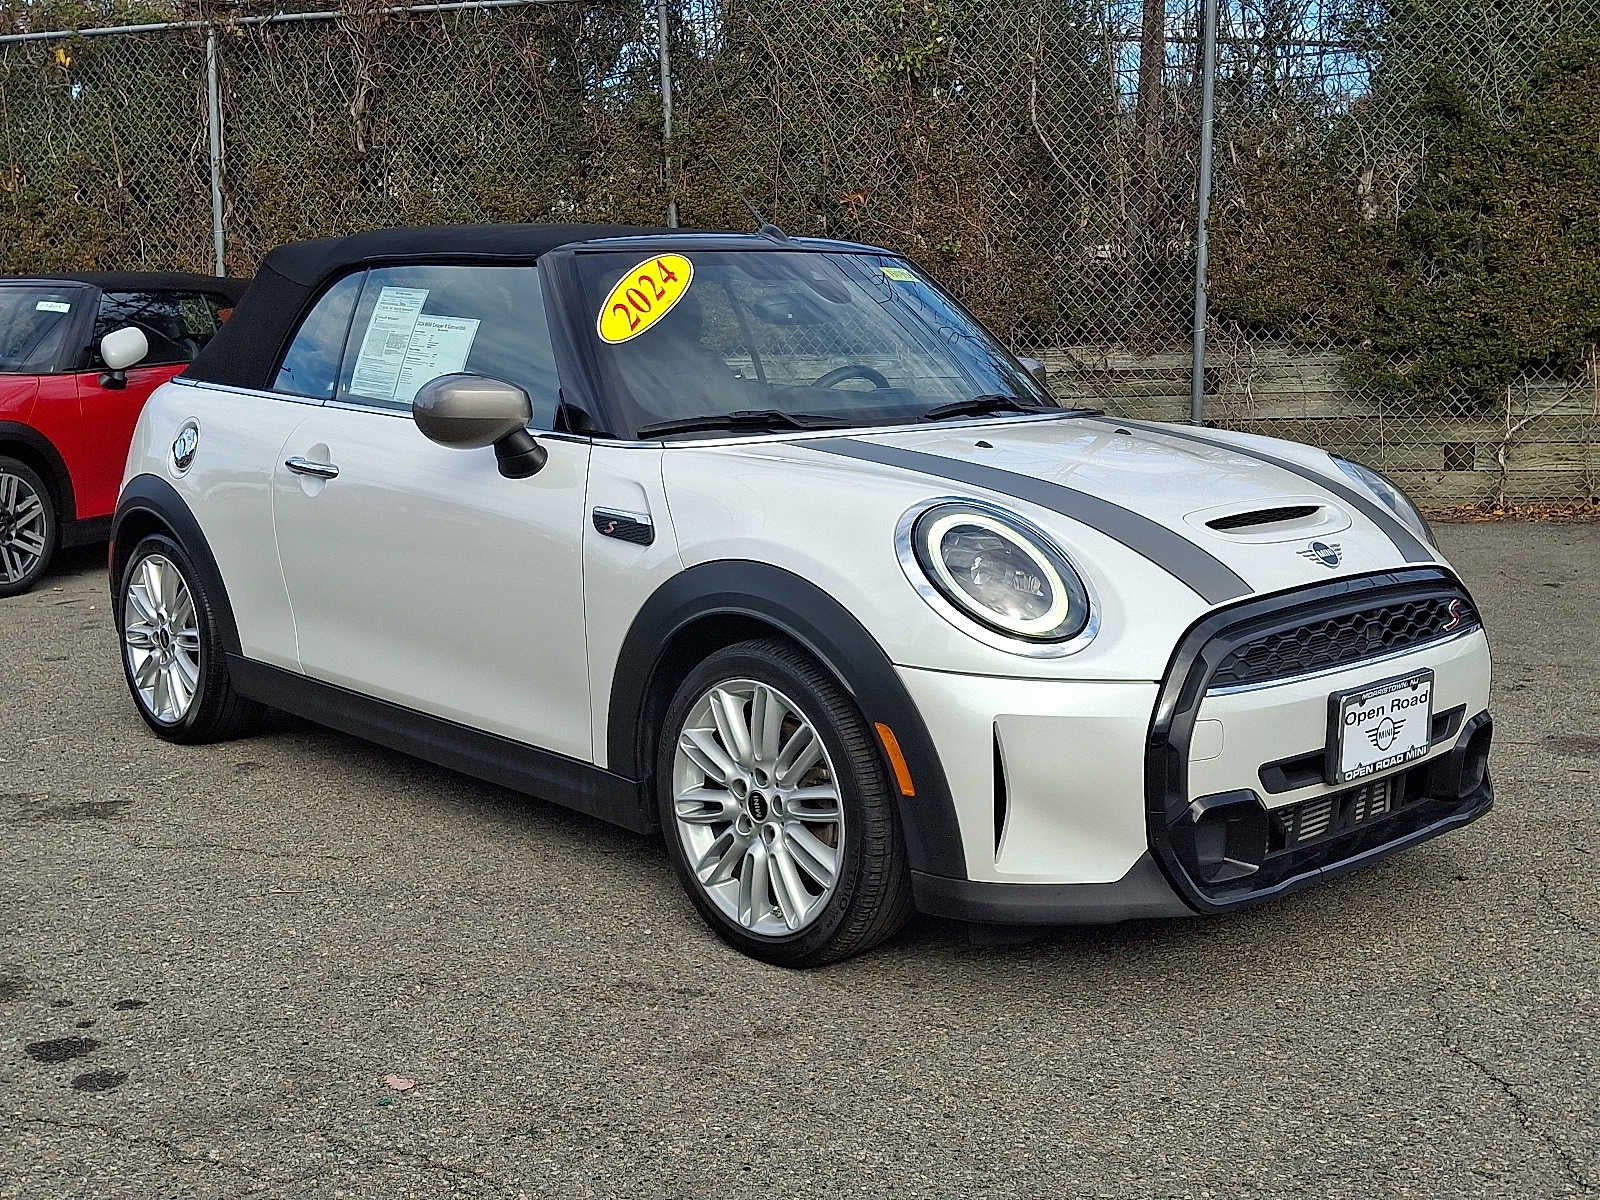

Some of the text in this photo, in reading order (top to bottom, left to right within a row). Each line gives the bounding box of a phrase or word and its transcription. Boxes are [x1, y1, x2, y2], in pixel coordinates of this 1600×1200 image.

[613, 260, 678, 331] 2024
[603, 520, 618, 534] S
[1443, 599, 1461, 632] S
[1345, 690, 1429, 727] Open Road
[1378, 728, 1393, 740] MINI
[1345, 746, 1427, 782] OPEN ROAD MINI
[752, 795, 763, 818] MINI
